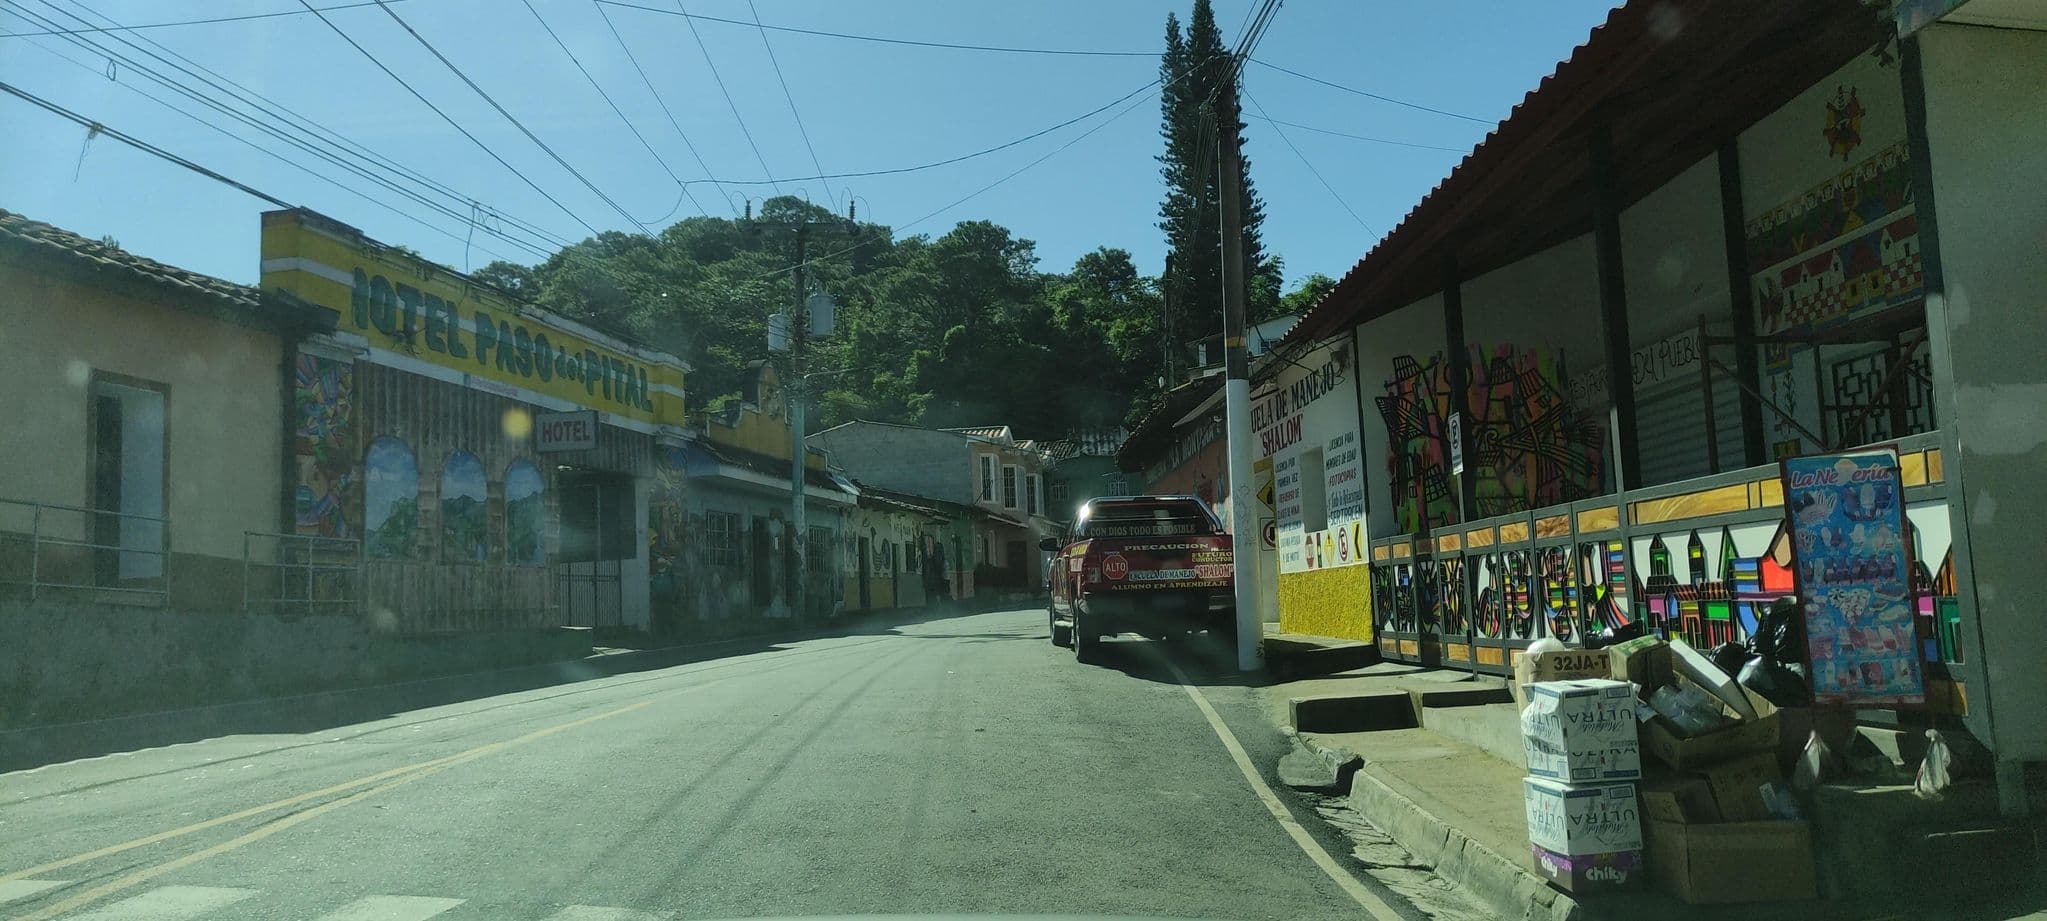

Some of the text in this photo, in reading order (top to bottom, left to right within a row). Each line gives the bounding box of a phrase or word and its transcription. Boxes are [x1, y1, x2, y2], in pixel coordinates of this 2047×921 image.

[475, 310, 552, 383] PASO
[584, 348, 653, 413] PITAL
[1250, 362, 1334, 434] UELA DE MANEJO
[542, 418, 591, 442] HOTEL
[1814, 464, 1892, 487] Neería
[1090, 527, 1107, 536] CON
[1108, 526, 1128, 535] DIOS
[1130, 526, 1150, 535] TODO
[1125, 543, 1209, 551] PRECAUCION
[1105, 562, 1126, 572] ALTO
[1169, 580, 1228, 589] APRENDIZAJE
[1567, 709, 1632, 722] ULTRA
[1569, 809, 1635, 825] ULTRA
